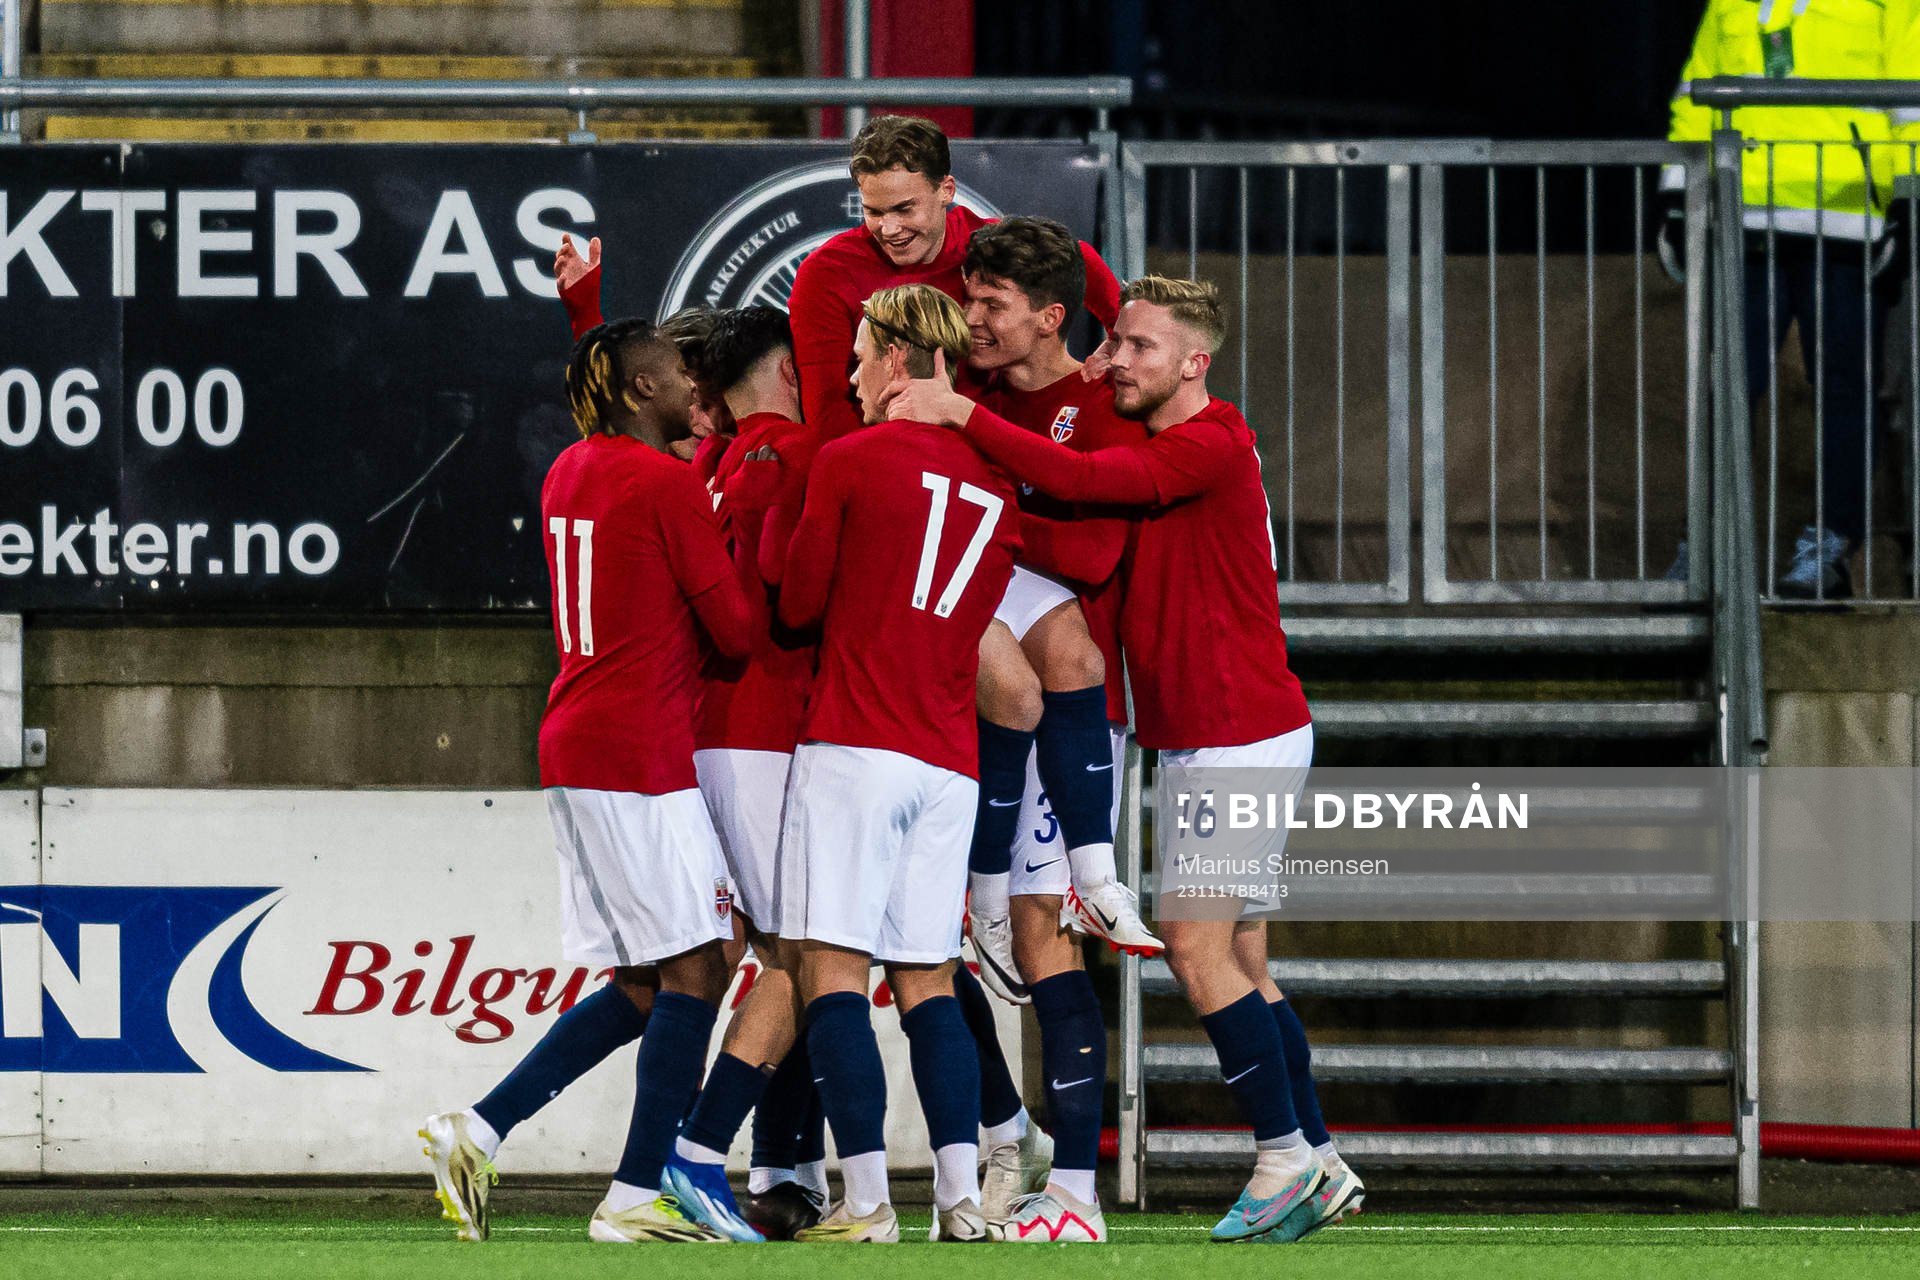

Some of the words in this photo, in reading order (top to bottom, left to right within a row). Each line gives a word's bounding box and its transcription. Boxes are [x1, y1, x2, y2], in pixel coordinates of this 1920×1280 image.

[0, 189, 369, 298] KTER
[403, 187, 596, 298] AS
[704, 210, 801, 310] ARKITEKTUR
[0, 367, 101, 447] 06
[136, 367, 244, 447] 00
[0, 504, 340, 576] ekter.no
[549, 516, 594, 656] 11
[911, 471, 1005, 619] 17
[1033, 790, 1059, 845] 3
